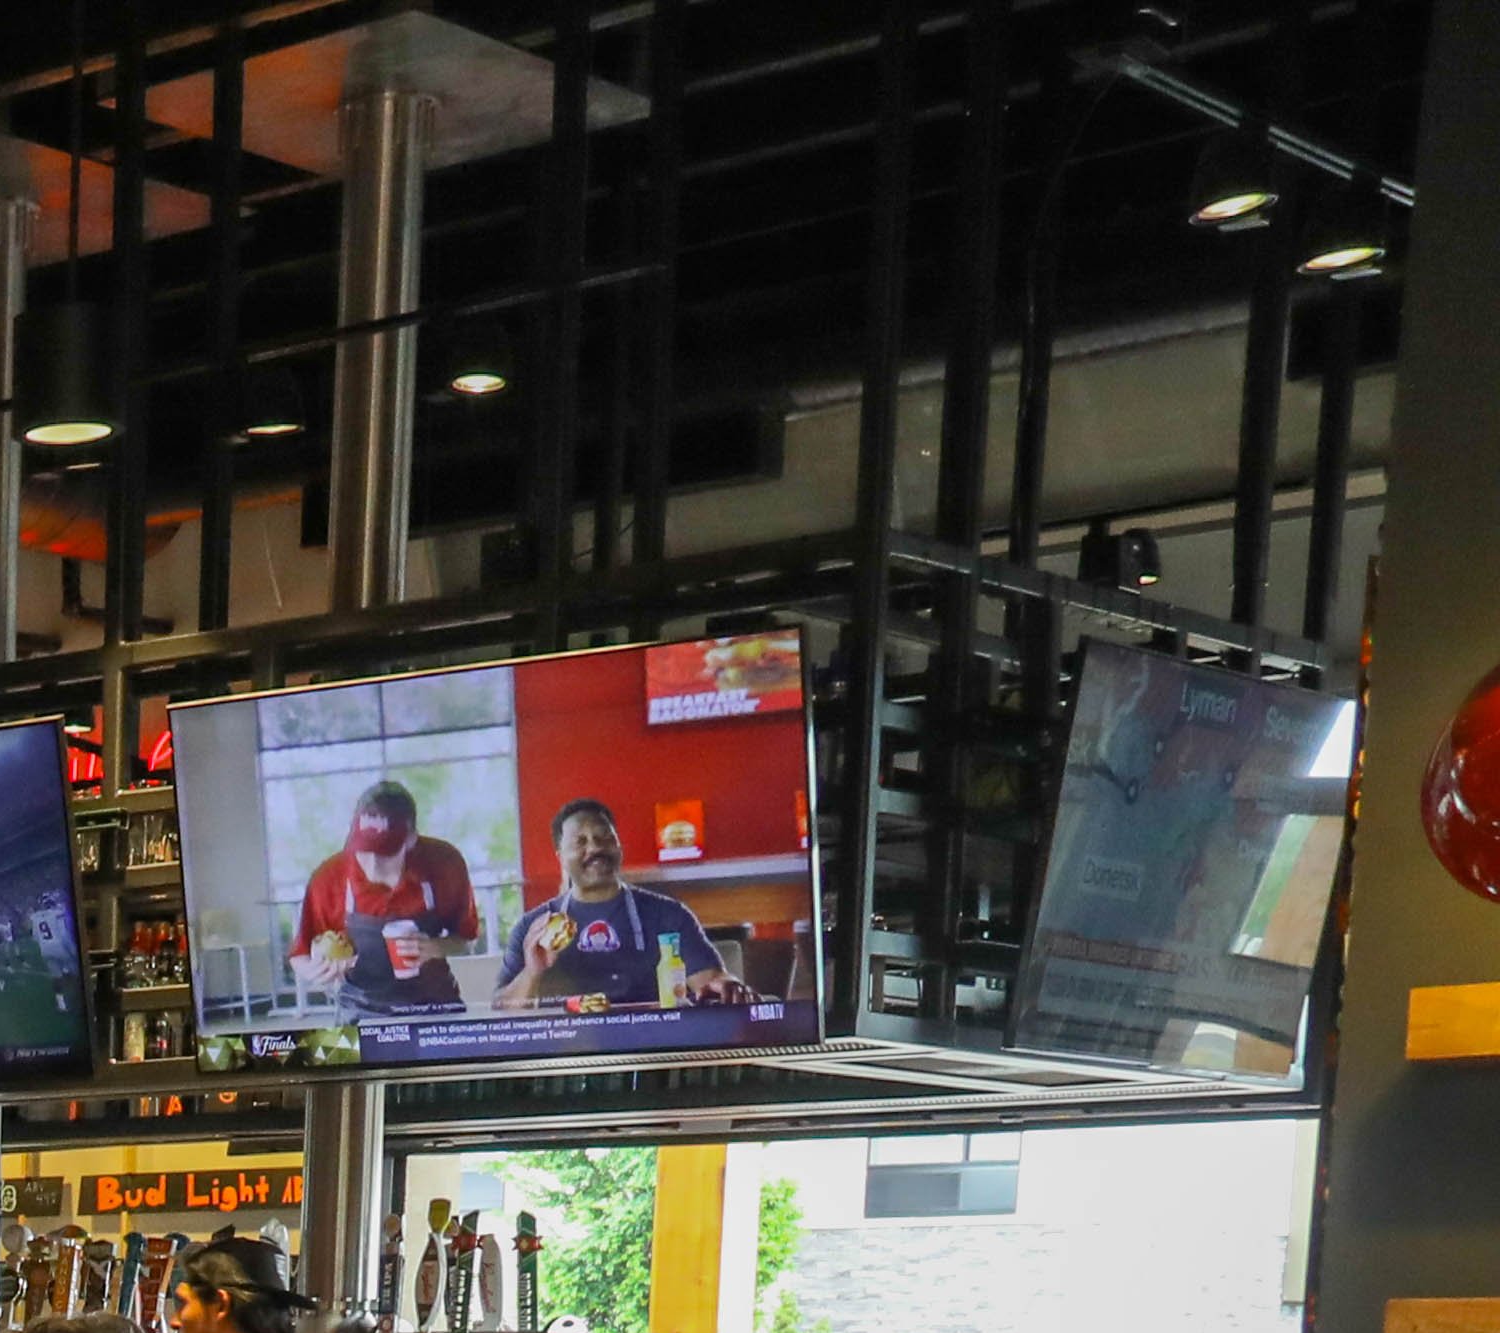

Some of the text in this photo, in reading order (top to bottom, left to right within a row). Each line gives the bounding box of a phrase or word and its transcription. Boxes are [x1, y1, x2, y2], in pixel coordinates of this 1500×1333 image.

[1181, 679, 1237, 724] Lyman
[360, 1024, 410, 1037] SOCIAL JUSTICE
[418, 1011, 681, 1035] work to dismantle racial inequality and advance social justice, visit
[259, 1035, 296, 1057] Finals
[376, 1032, 411, 1043] COALITION
[490, 1029, 530, 1043] Instagram
[531, 1029, 548, 1040] and
[549, 1027, 577, 1039] Twitter
[97, 1173, 167, 1212] Bud
[186, 1172, 270, 1212] Light
